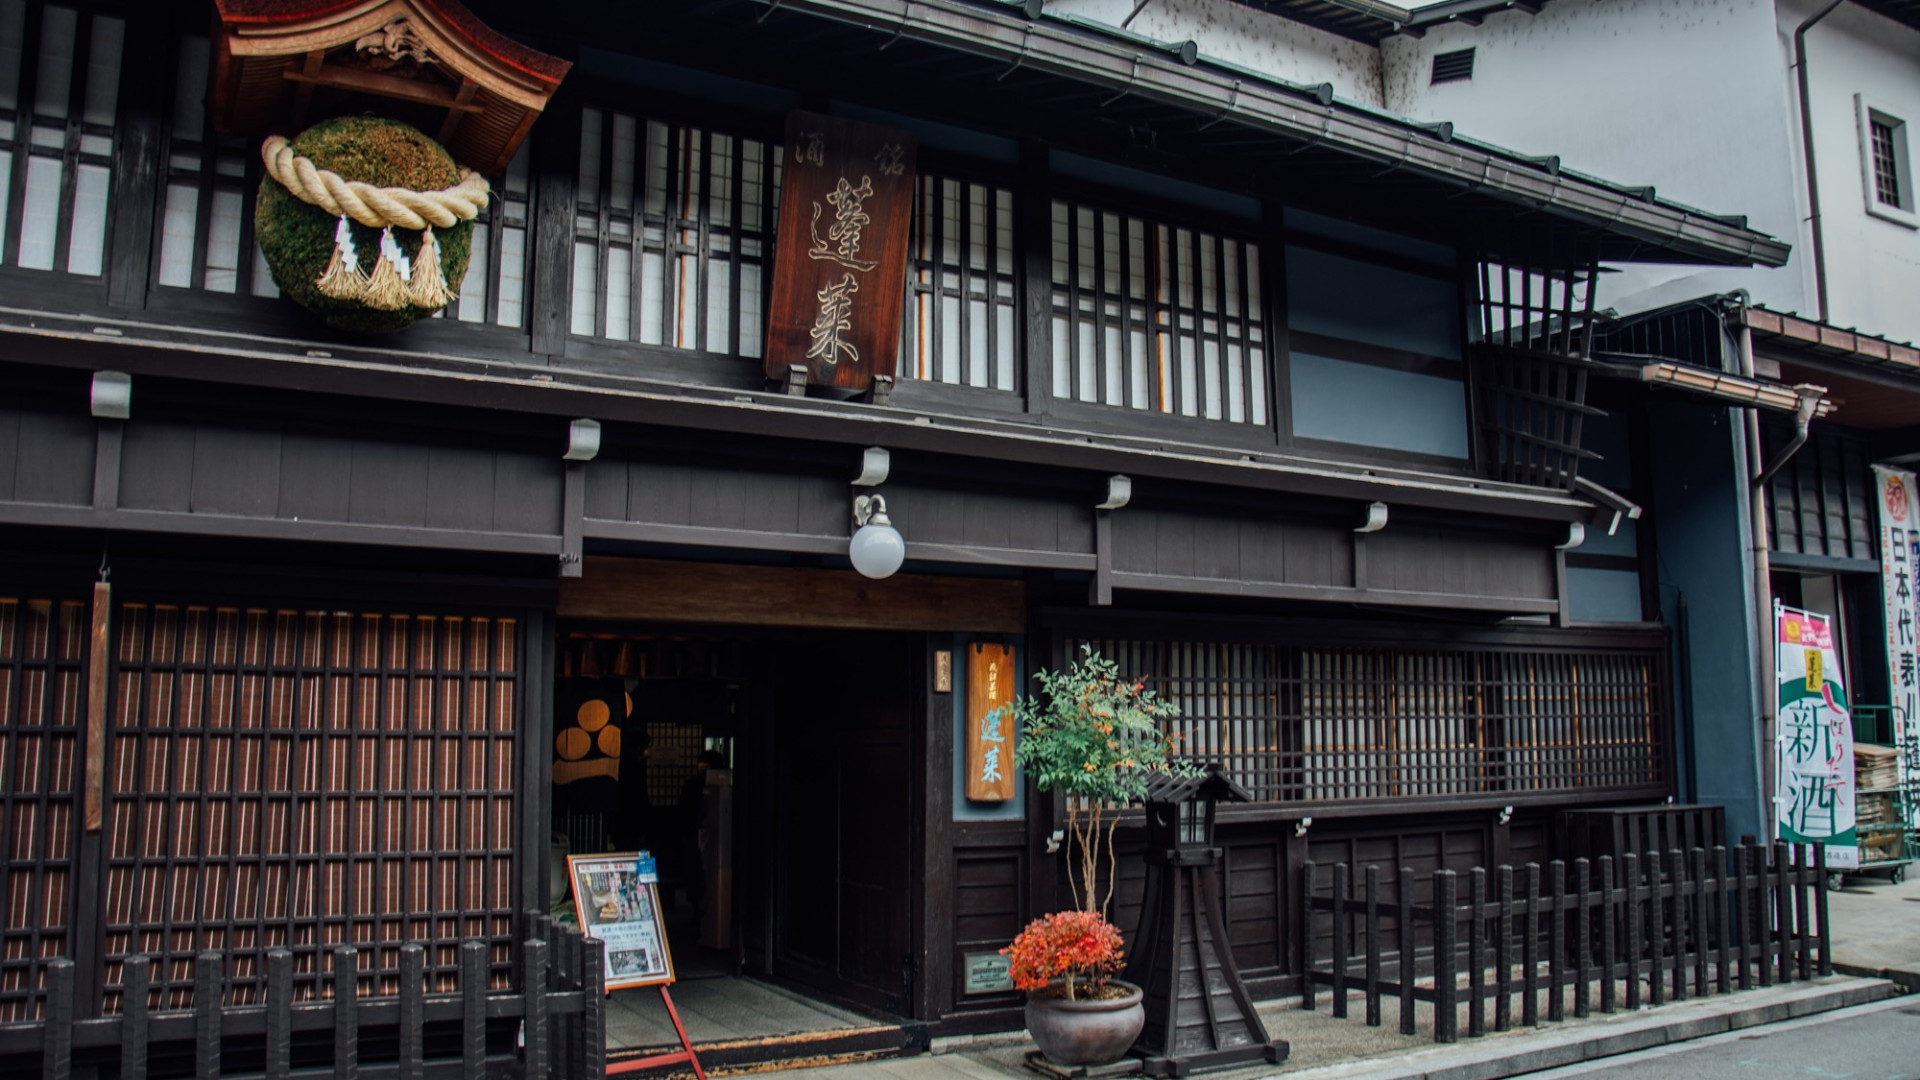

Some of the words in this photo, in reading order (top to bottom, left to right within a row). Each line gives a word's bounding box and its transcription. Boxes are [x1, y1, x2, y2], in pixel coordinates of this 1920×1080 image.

[1786, 699, 1836, 836] 新酒
[1821, 682, 1847, 806] しぼりたて
